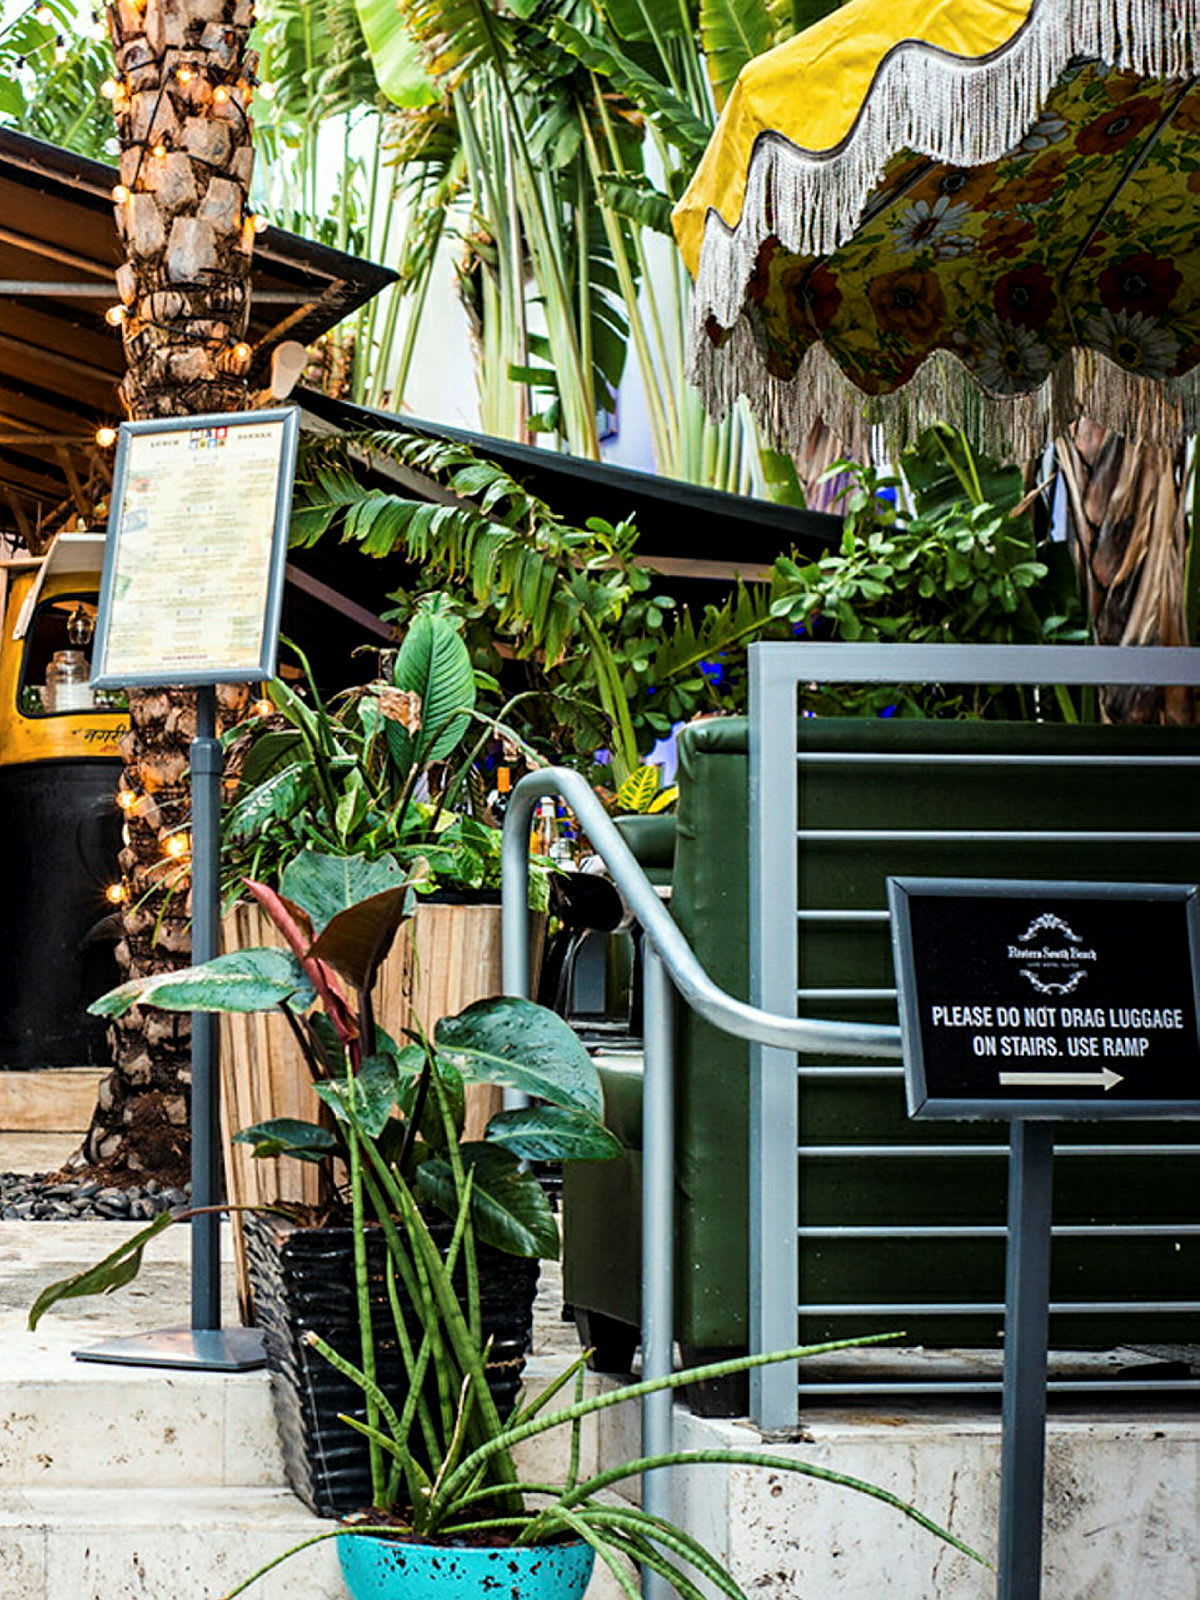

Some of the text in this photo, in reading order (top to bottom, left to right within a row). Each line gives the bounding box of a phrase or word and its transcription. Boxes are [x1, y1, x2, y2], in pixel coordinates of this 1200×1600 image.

[1042, 946, 1069, 961] South
[932, 1006, 1184, 1029] PLEASE DO NOT DRAG LUGGAGE
[973, 1036, 1149, 1057] ON STAIRS. USE RAMP
